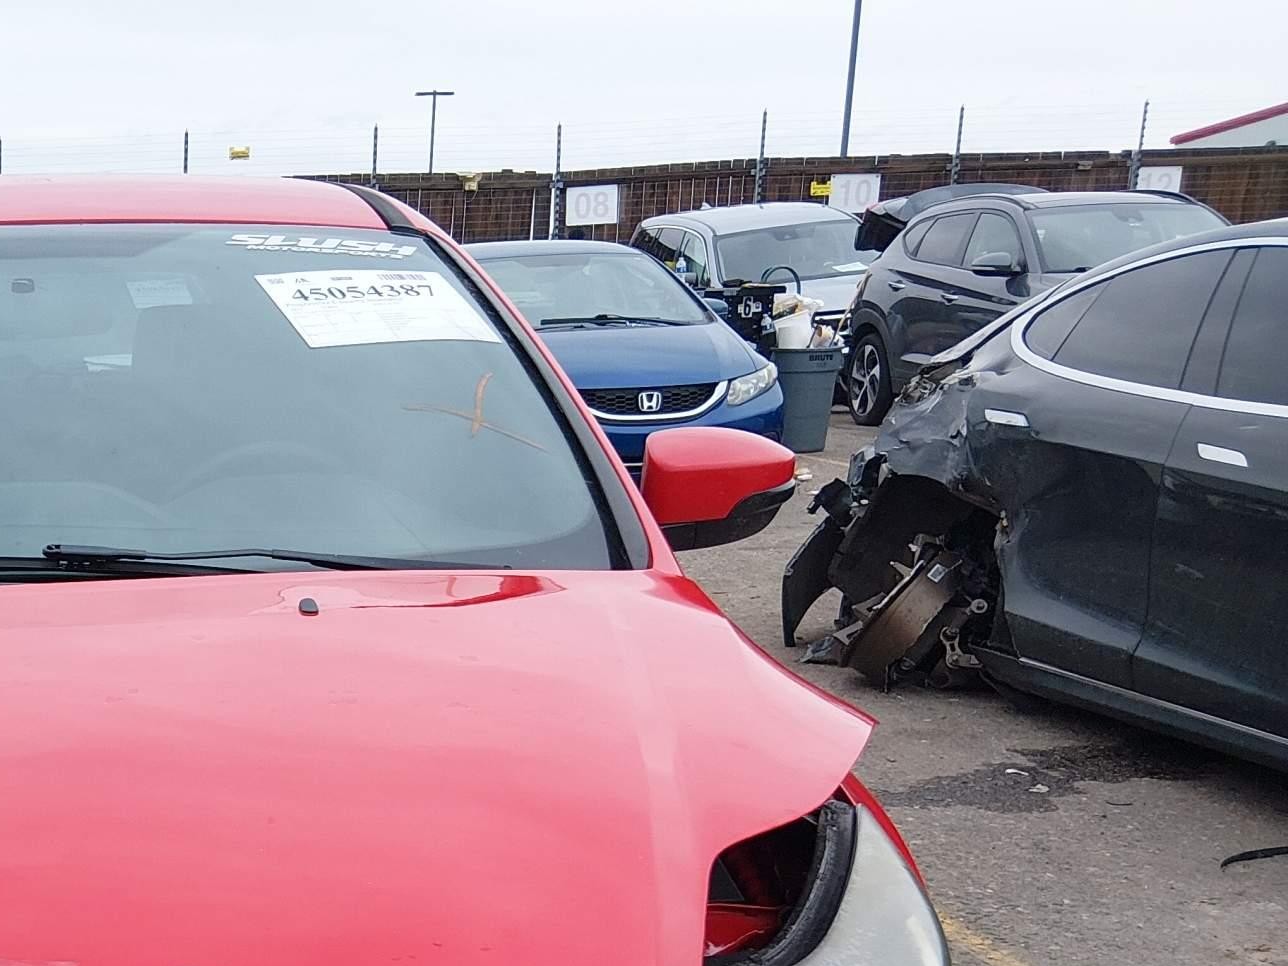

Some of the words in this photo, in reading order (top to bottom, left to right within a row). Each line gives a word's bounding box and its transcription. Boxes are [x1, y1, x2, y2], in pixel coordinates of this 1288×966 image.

[840, 179, 872, 207] 10
[574, 191, 609, 219] 08
[225, 234, 417, 256] SLUSH
[292, 284, 434, 301] 45054387
[742, 298, 752, 317] 6
